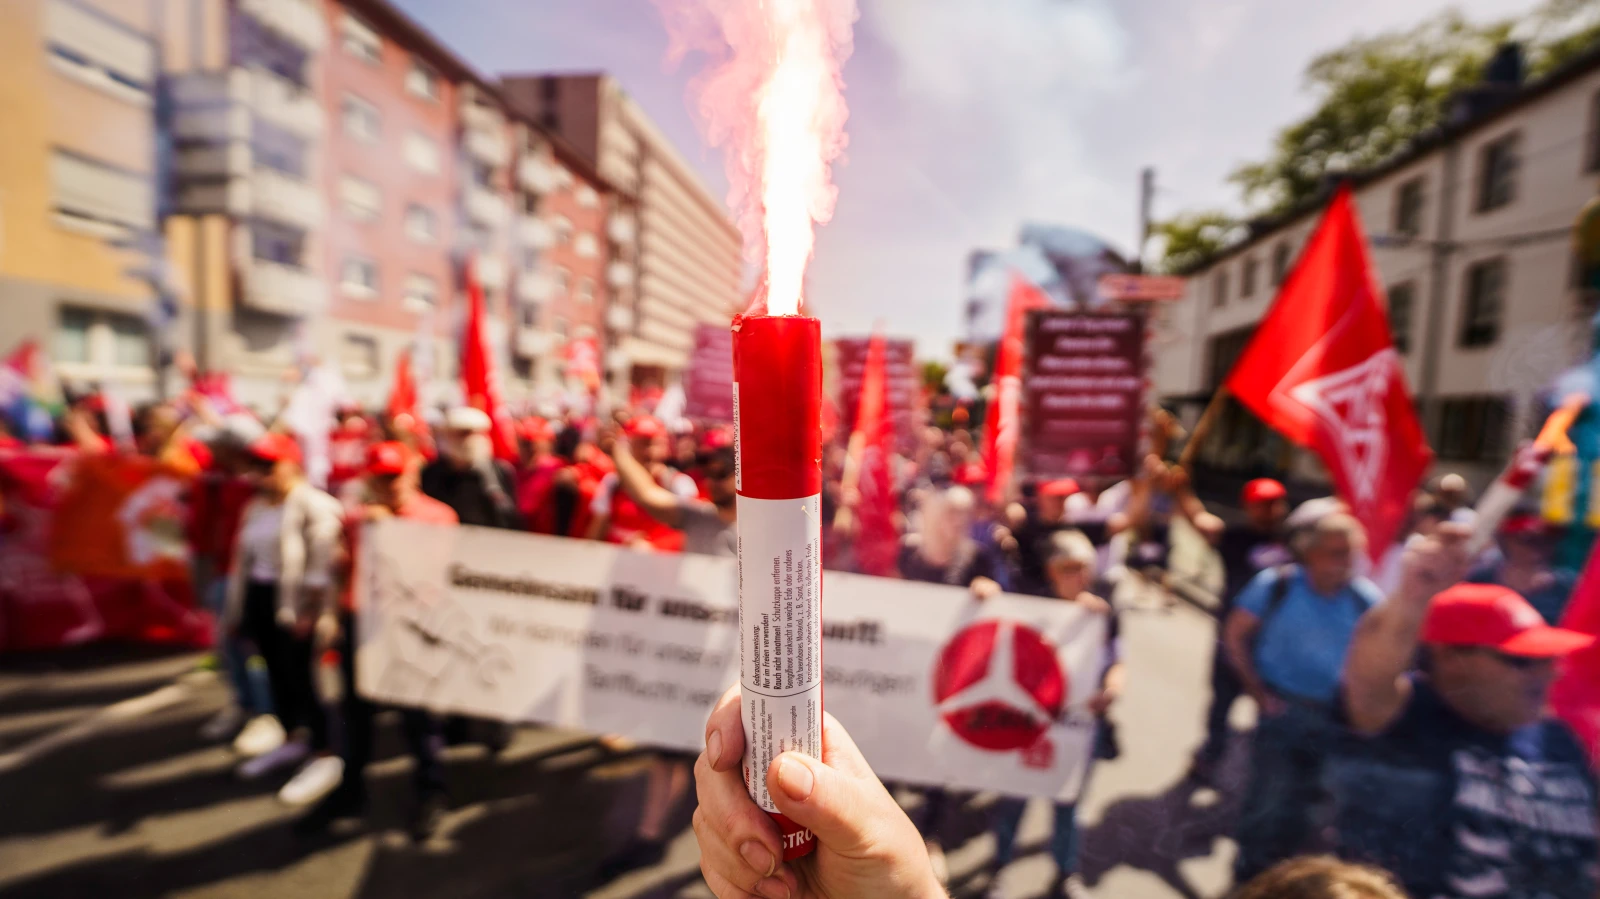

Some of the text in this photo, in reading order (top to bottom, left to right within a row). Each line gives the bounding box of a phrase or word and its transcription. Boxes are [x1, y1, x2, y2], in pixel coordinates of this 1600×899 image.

[783, 549, 793, 573] anderes
[795, 559, 804, 583] stecken.
[447, 561, 600, 604] Gemeinsam
[610, 584, 648, 612] für
[784, 573, 793, 586] oder
[784, 587, 793, 600] Erde
[796, 583, 805, 602] Sand,
[771, 556, 782, 690] Rauch nicht einatmen! Schutzkappe entfernen.
[784, 602, 793, 622] weiche
[761, 612, 770, 648] verwenden!
[796, 616, 805, 642] Material,
[784, 629, 793, 656] senkrecht
[752, 624, 761, 687] Gebrauchsanweisung:
[762, 649, 770, 668] Freien
[796, 642, 804, 673] brennbares
[763, 669, 770, 677] im
[796, 673, 804, 687] nicht
